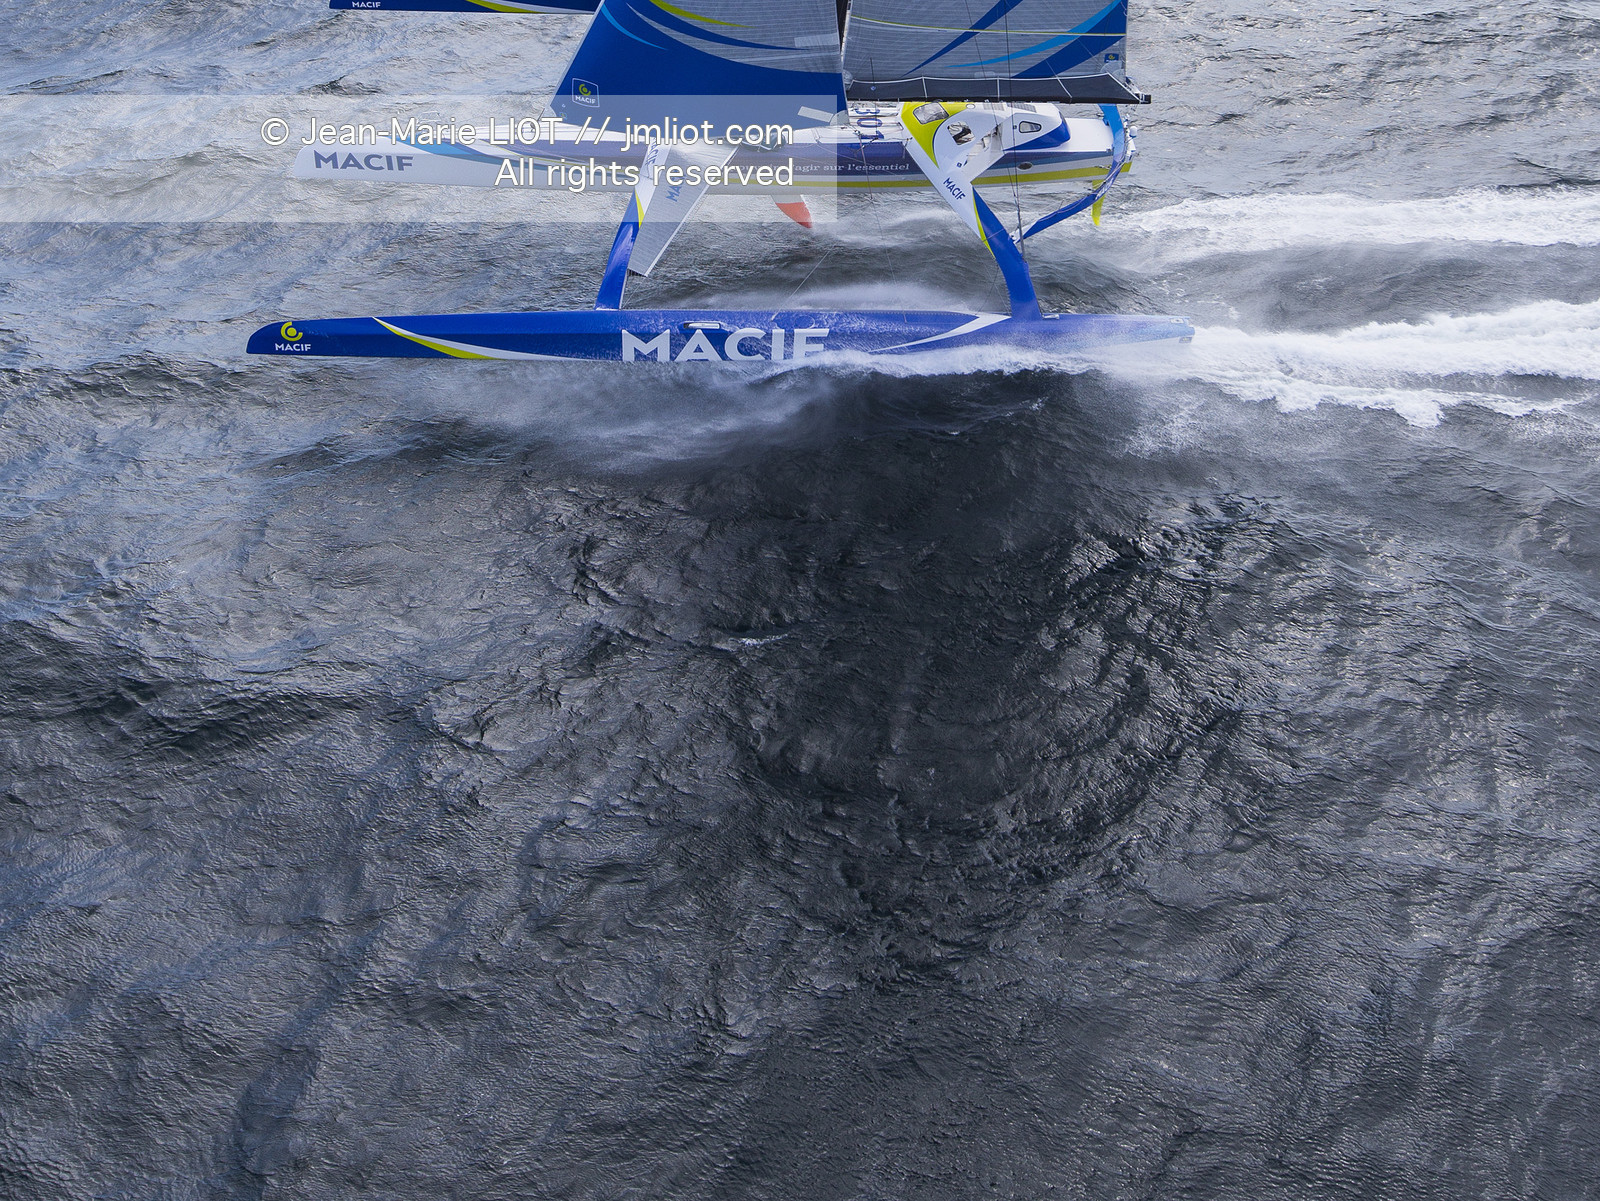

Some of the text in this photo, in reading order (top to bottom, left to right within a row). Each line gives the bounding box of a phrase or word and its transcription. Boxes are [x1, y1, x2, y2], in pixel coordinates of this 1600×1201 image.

[575, 95, 596, 104] MACIF
[313, 150, 413, 171] MACIF
[848, 163, 910, 171] l'essentiel
[943, 177, 966, 200] MACIF
[275, 343, 312, 351] MACIF
[621, 328, 830, 362] MACIF
